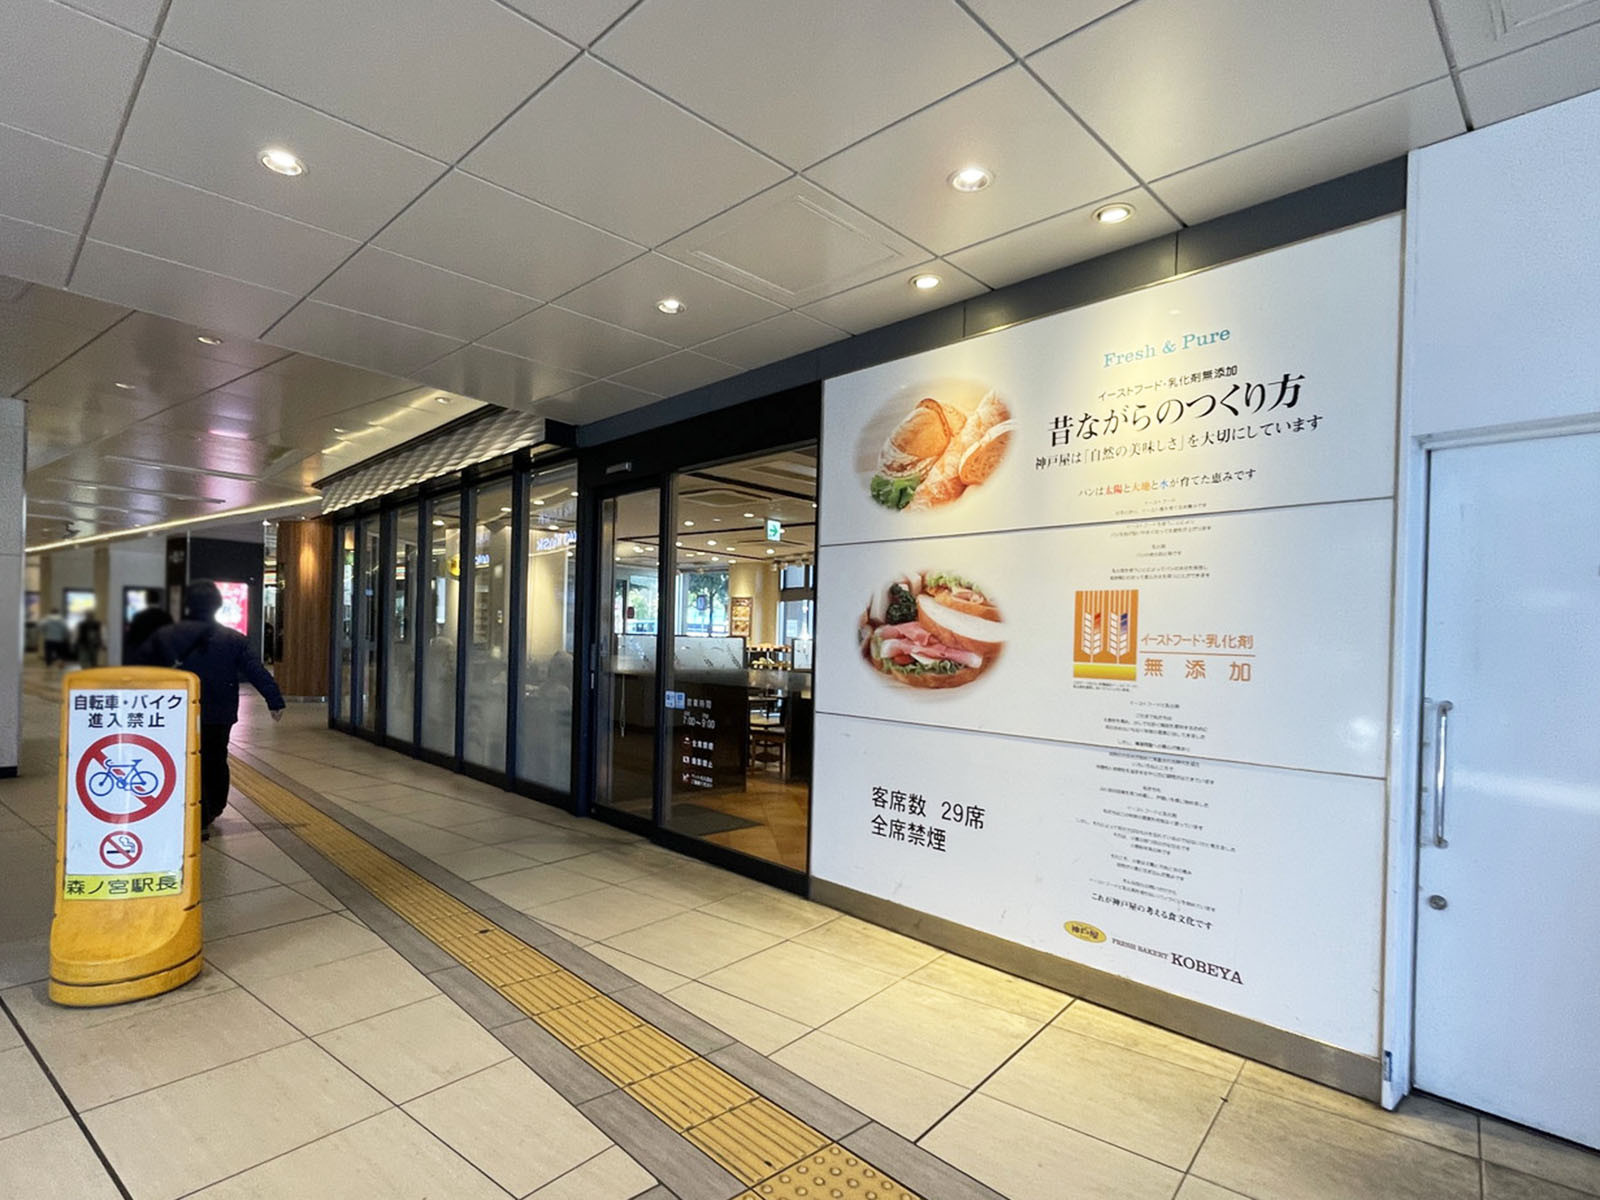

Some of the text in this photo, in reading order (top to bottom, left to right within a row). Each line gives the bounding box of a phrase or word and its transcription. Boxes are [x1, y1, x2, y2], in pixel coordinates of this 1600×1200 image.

[1103, 328, 1231, 368] Fresh & Pure
[1048, 373, 1305, 447] 昔ながらのつくり方
[74, 694, 183, 711] 自転車・バイク
[88, 712, 166, 728] 進入禁止
[871, 786, 986, 830] 客席数 29席
[871, 814, 946, 852] 全席禁煙
[66, 875, 178, 896] 森ノ宮駅長
[1170, 952, 1244, 985] KOBEYA
